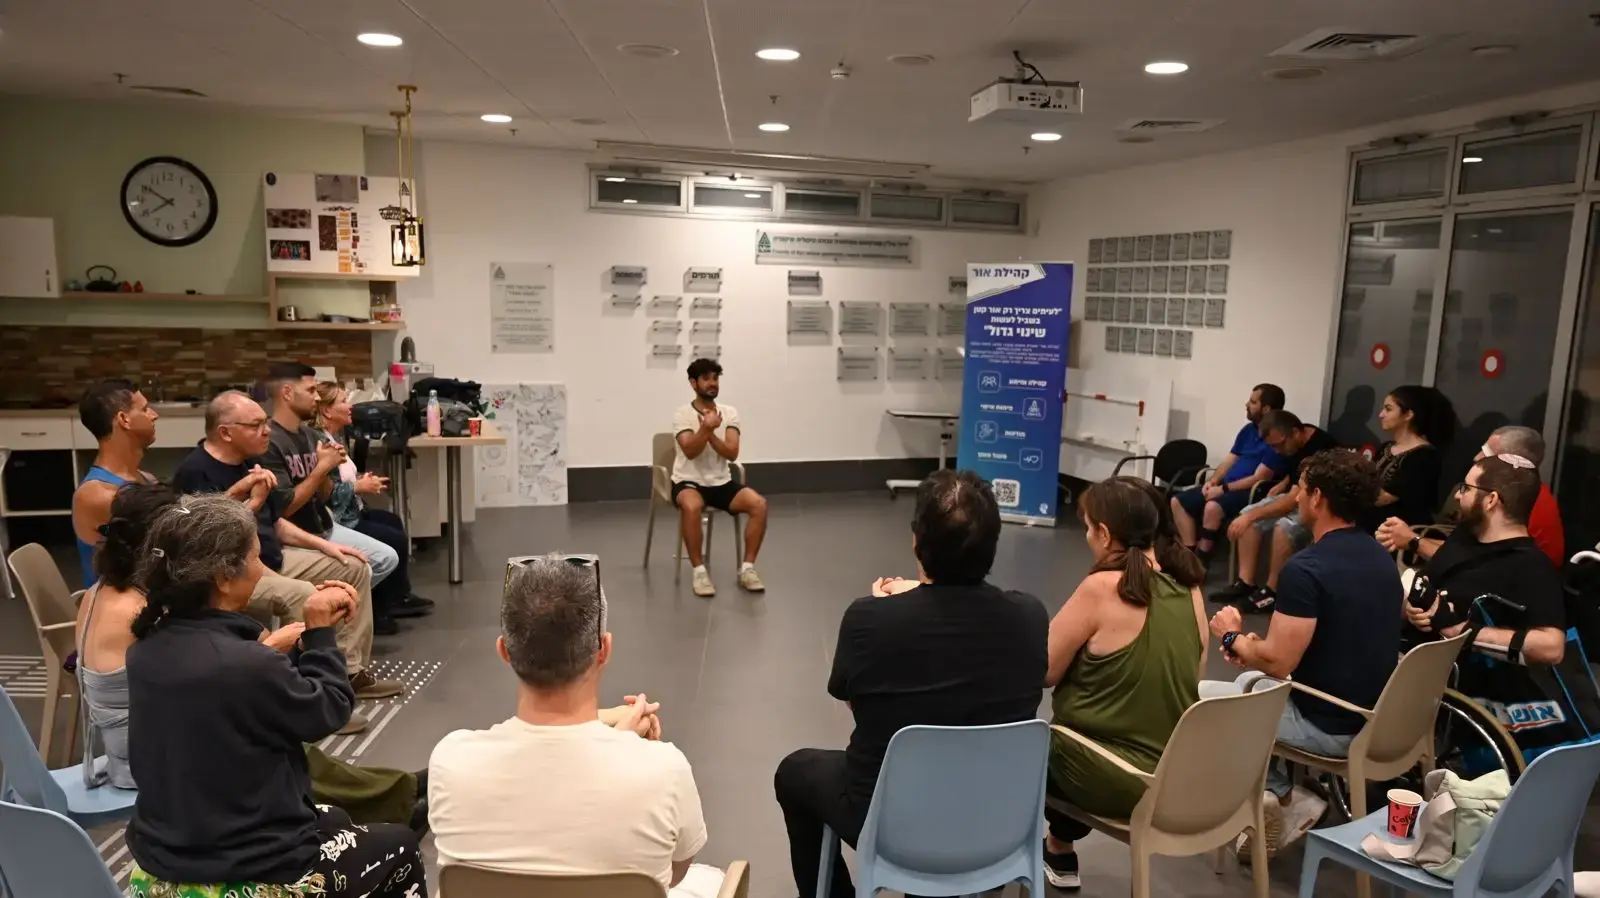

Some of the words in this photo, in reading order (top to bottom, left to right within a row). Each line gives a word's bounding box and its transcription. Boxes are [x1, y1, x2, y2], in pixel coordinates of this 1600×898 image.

[163, 171, 174, 182] 12
[973, 268, 992, 278] אור
[994, 267, 1030, 279] קהילת
[973, 306, 988, 315] קטן
[1003, 307, 1013, 315] רק
[1015, 307, 1031, 316] צריך
[991, 316, 1016, 324] לעשות
[1017, 316, 1041, 325] בשביל
[1017, 327, 1047, 338] שינוי
